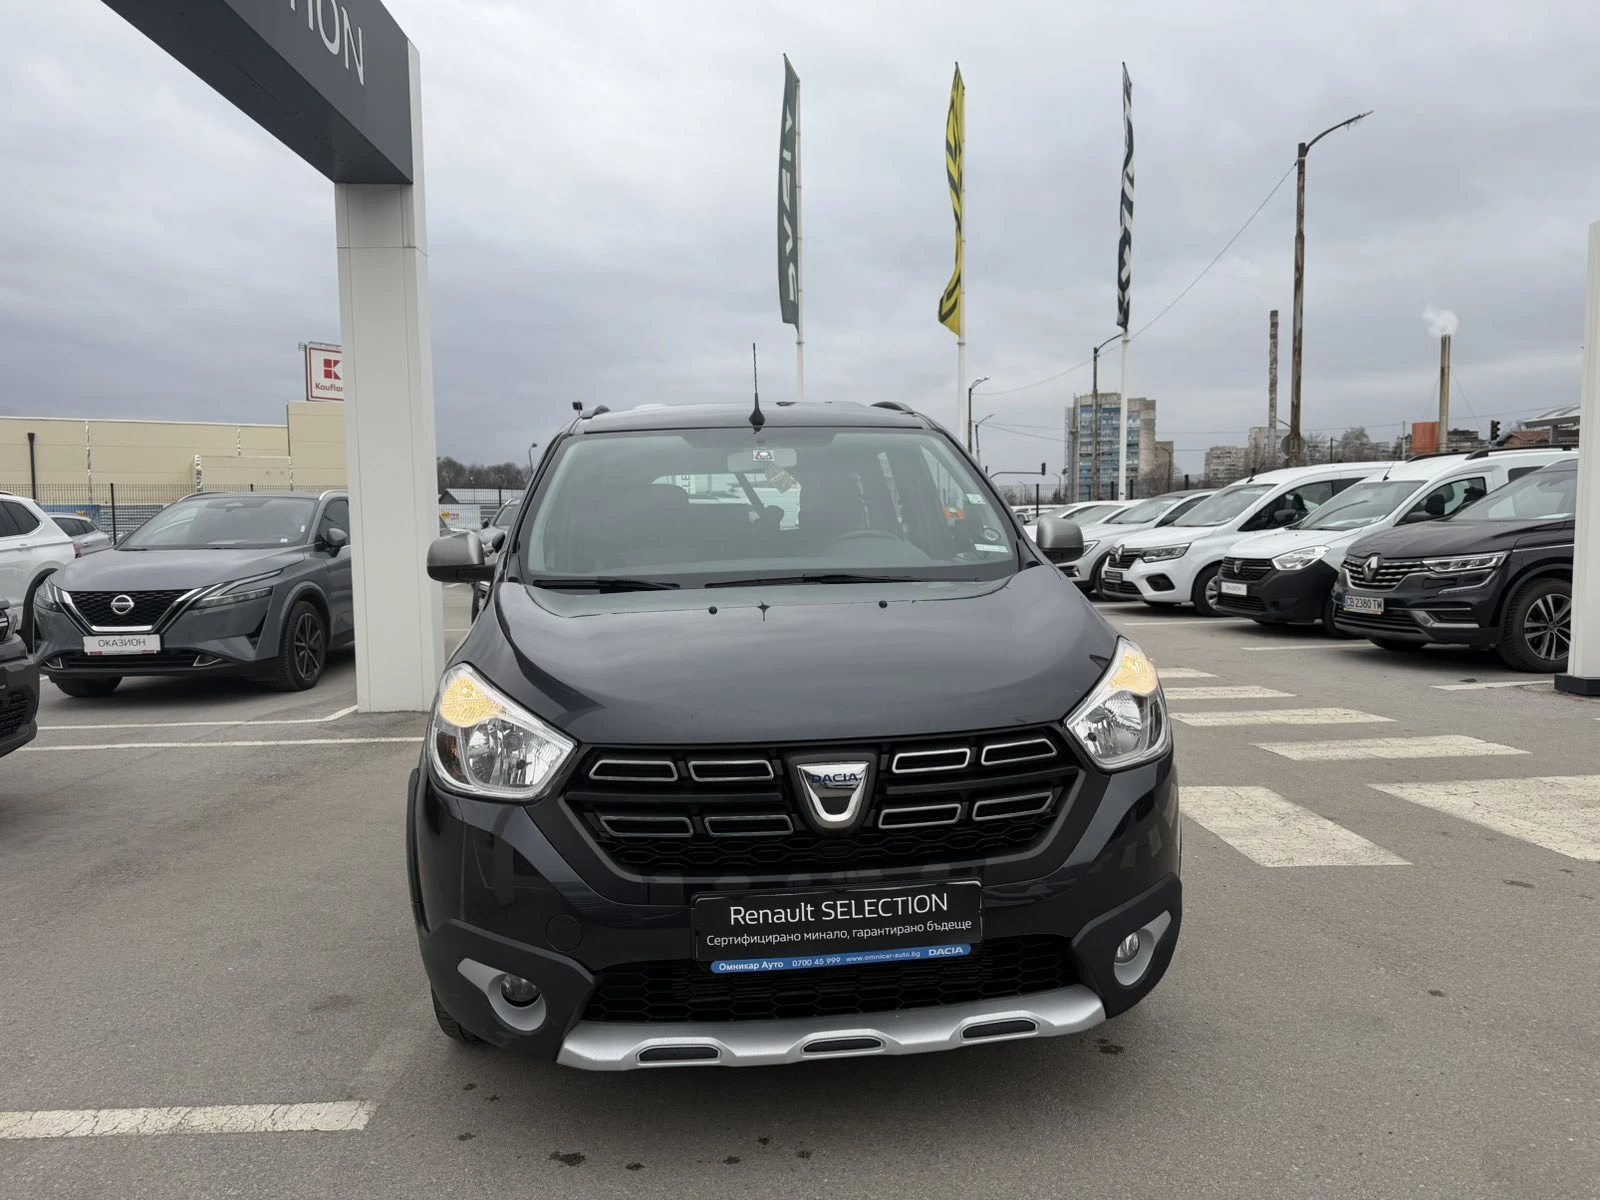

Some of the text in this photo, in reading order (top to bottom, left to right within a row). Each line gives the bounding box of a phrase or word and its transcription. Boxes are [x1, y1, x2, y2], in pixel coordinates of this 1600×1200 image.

[98, 638, 146, 648] ОКАЗИОН
[811, 773, 858, 784] DACIA
[729, 892, 948, 926] Renault SELECTION
[706, 920, 972, 947] Сертифицирано минало, гарантирано бъдеще
[718, 962, 760, 971] Омникар
[761, 960, 784, 970] Ауто
[792, 959, 812, 967] 0700
[845, 951, 921, 962] www.omnicar-auto.bg
[928, 946, 964, 956] DACIA
